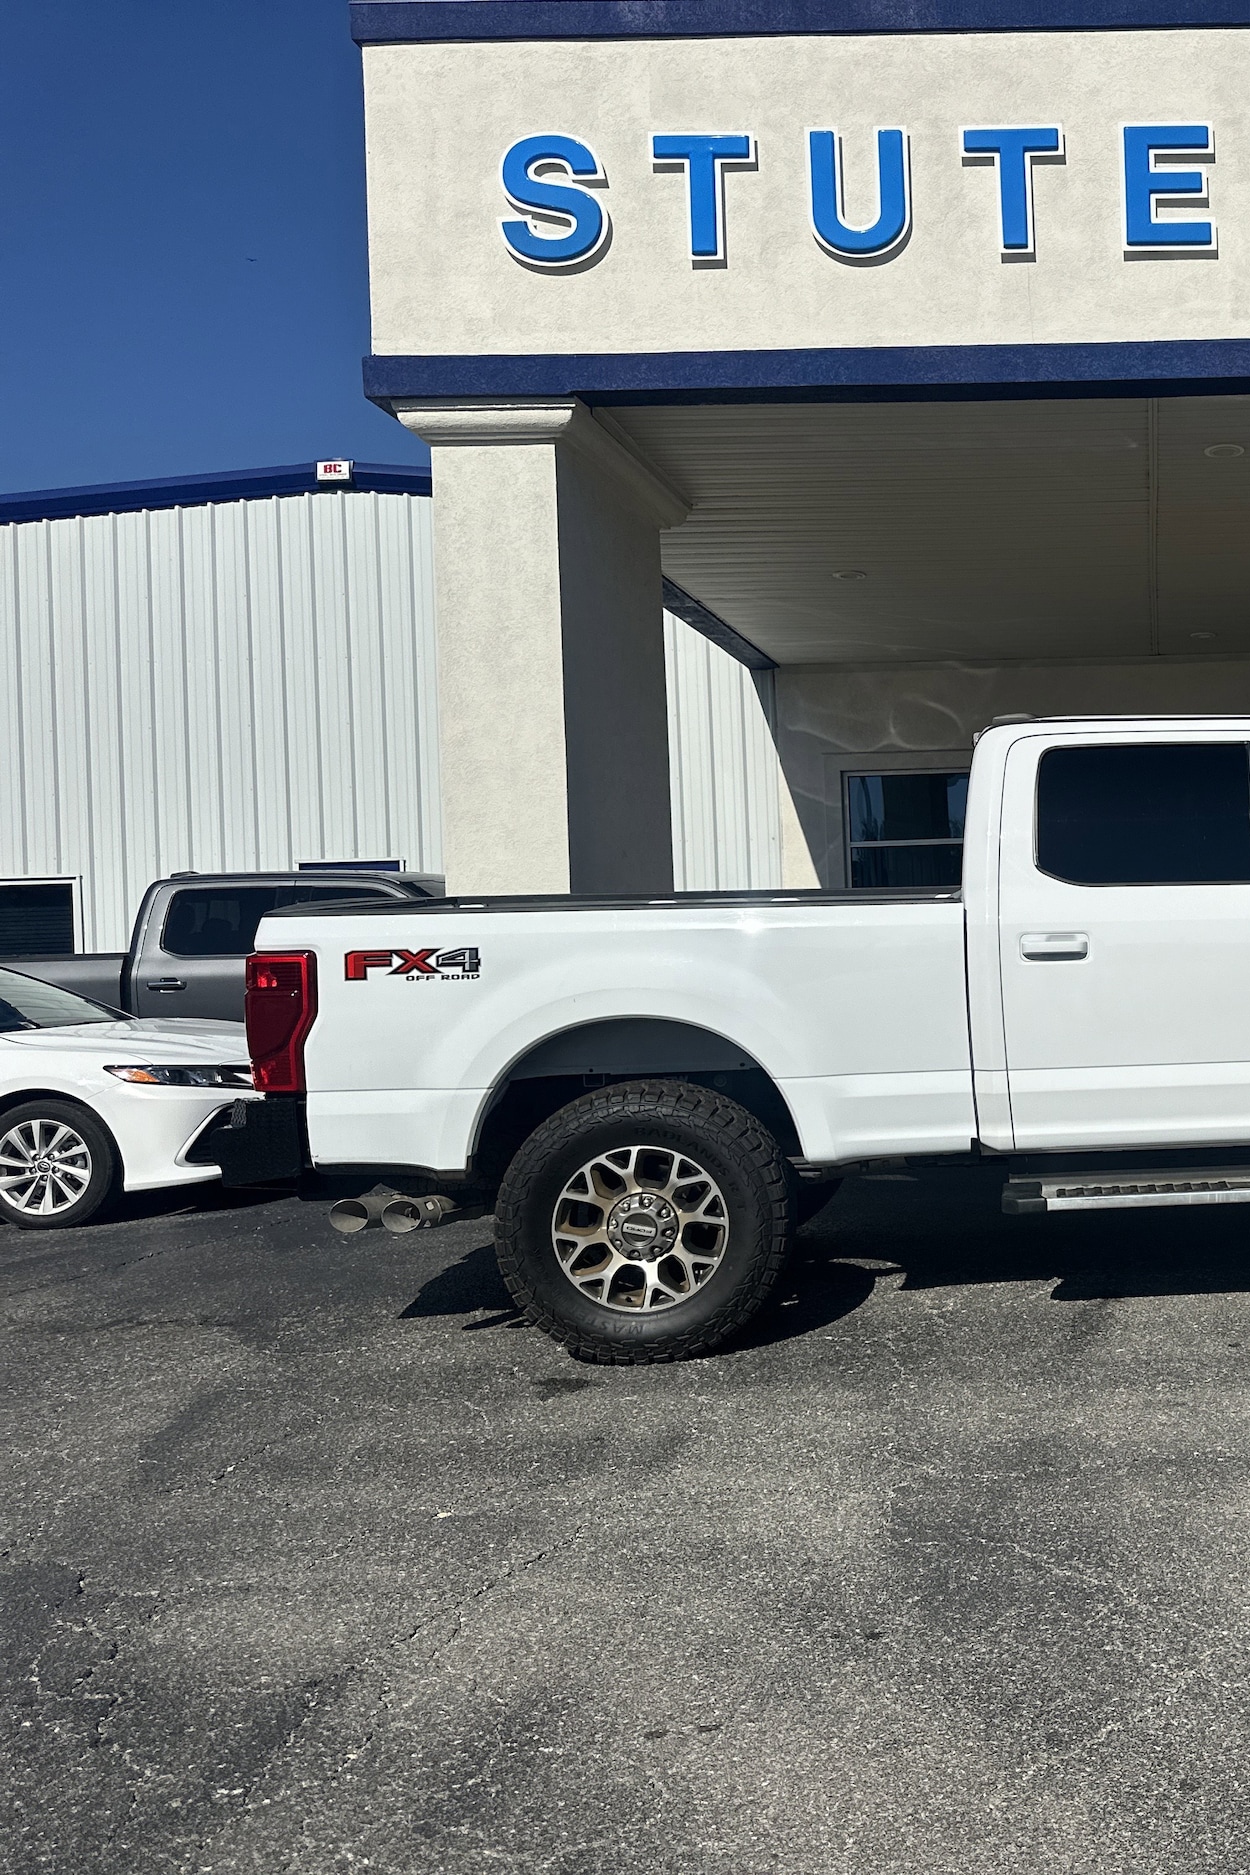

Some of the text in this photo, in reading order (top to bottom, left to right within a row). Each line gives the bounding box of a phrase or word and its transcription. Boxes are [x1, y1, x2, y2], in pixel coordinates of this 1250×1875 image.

[323, 464, 342, 474] BC
[344, 947, 482, 982] FX4
[405, 973, 481, 982] OFF ROAD
[633, 1126, 731, 1177] BADLANDS
